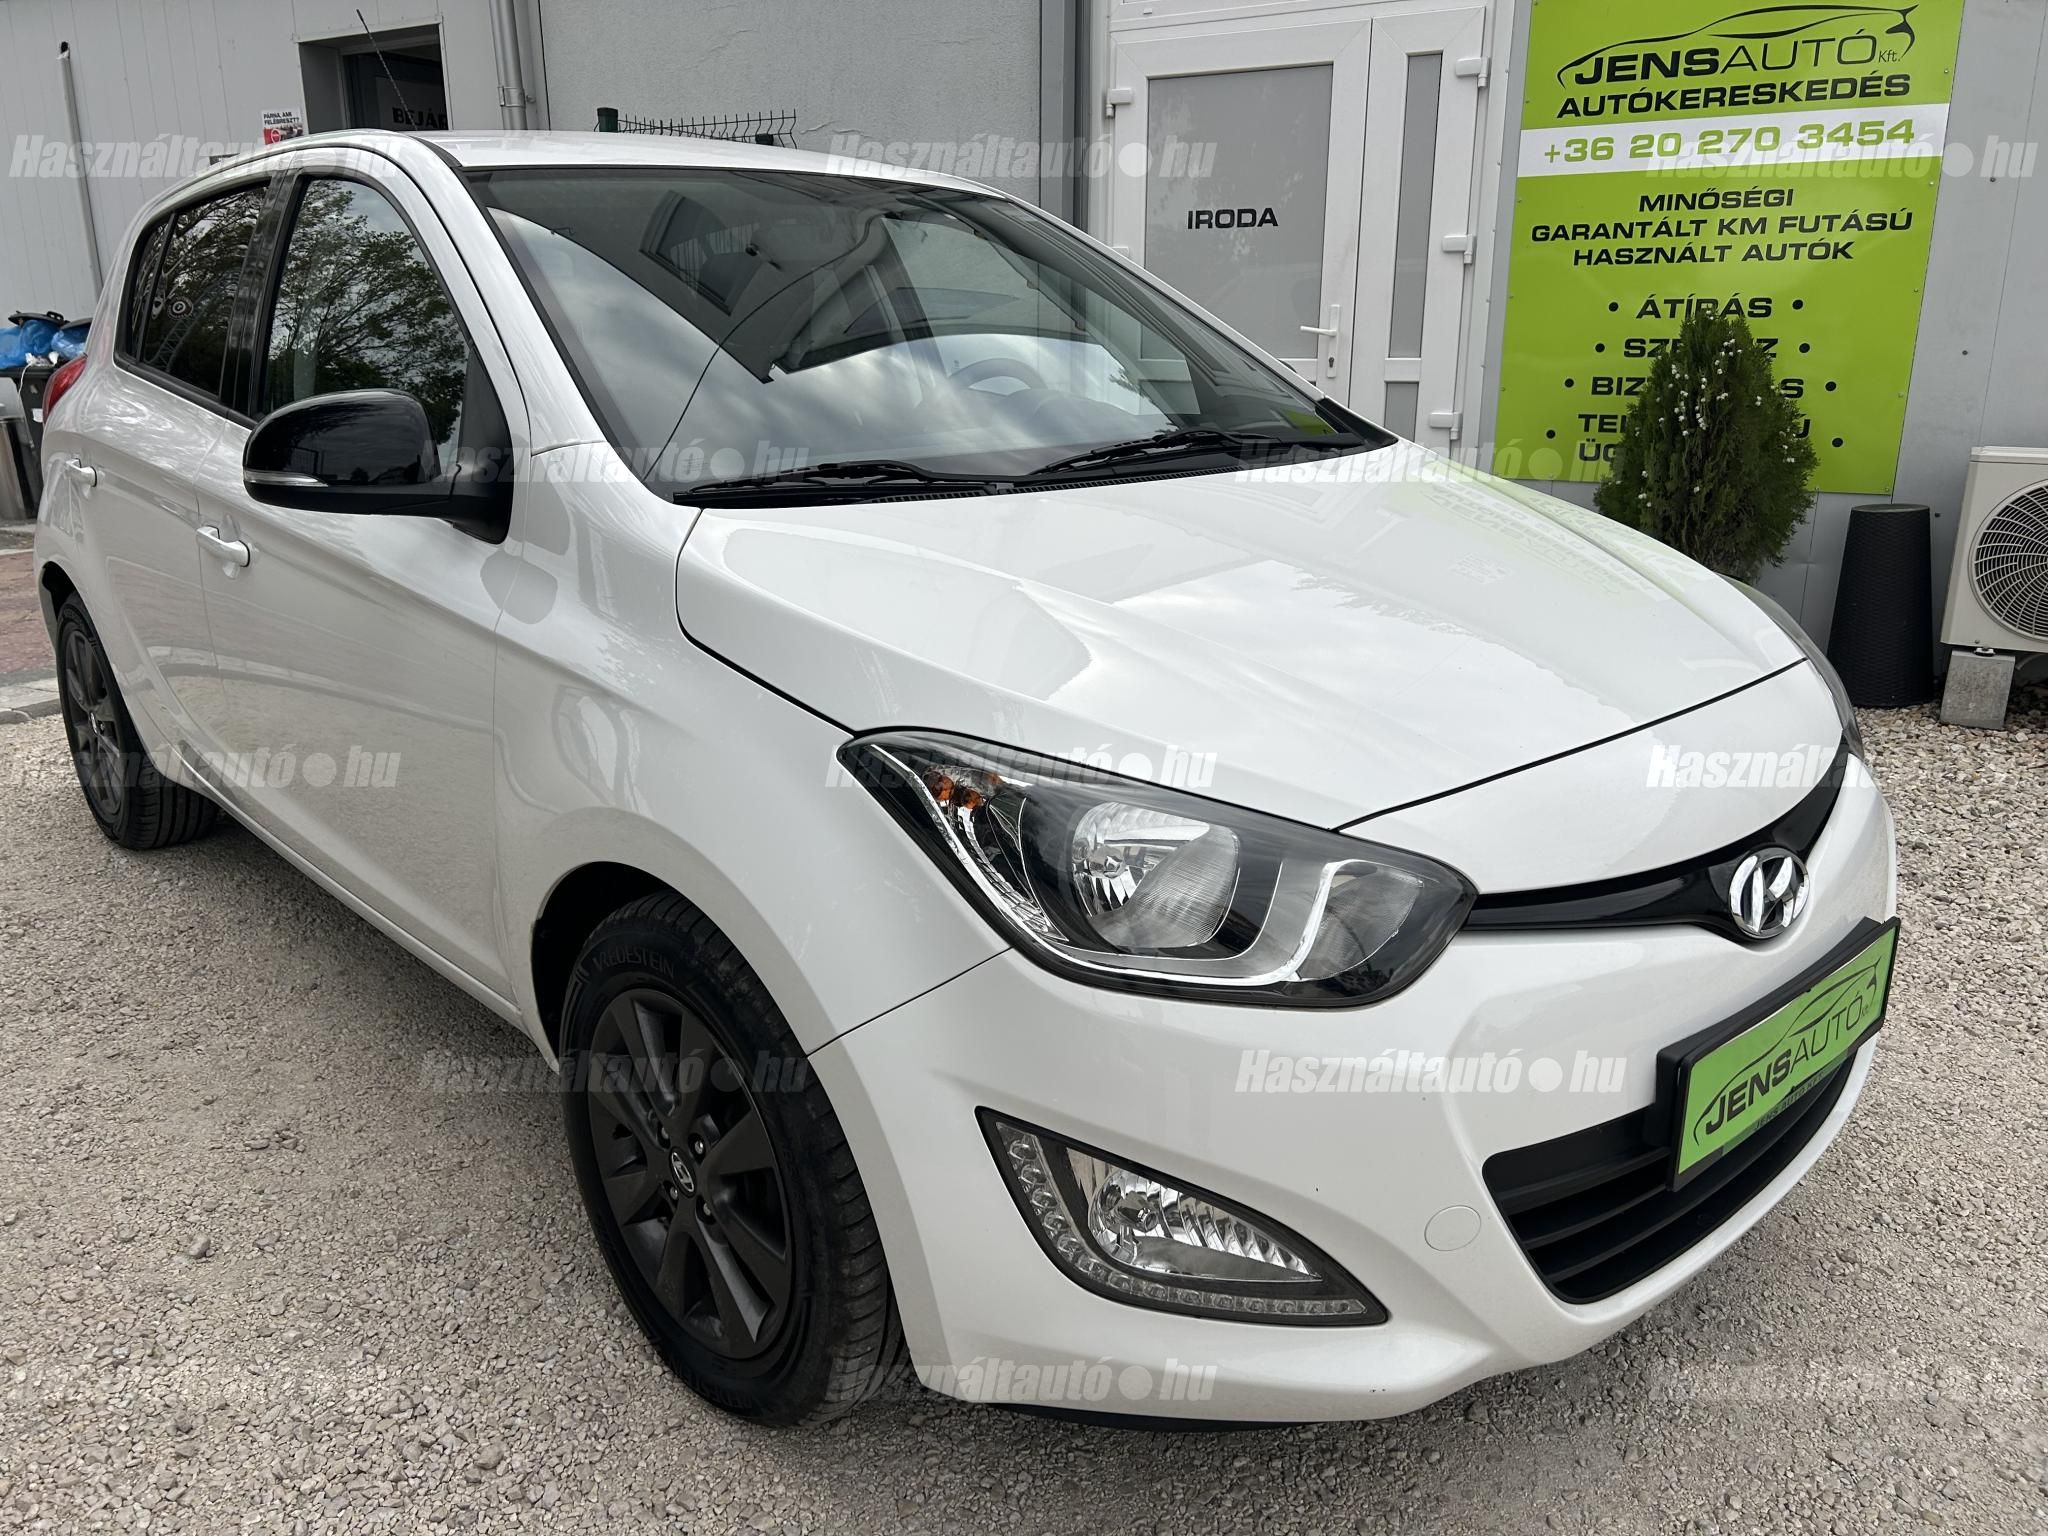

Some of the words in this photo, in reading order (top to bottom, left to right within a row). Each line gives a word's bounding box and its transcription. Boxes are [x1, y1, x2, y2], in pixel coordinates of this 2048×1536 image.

[1556, 73, 1912, 119] AUTÓKERESKEDÉS
[1544, 137, 1615, 164] +36
[1629, 133, 1683, 159] 20
[1697, 126, 1781, 154] 270
[1797, 118, 1915, 150] 3454
[1638, 186, 1794, 213] MINŐSÉGI
[1187, 207, 1279, 230] IRODA
[1531, 214, 1706, 242] GARANTÁLT
[1717, 216, 1768, 236] KM
[1778, 207, 1913, 234] FUTÁSÚ
[1573, 242, 1732, 266] HASZNÁLT
[1741, 240, 1854, 261] AUTÓK
